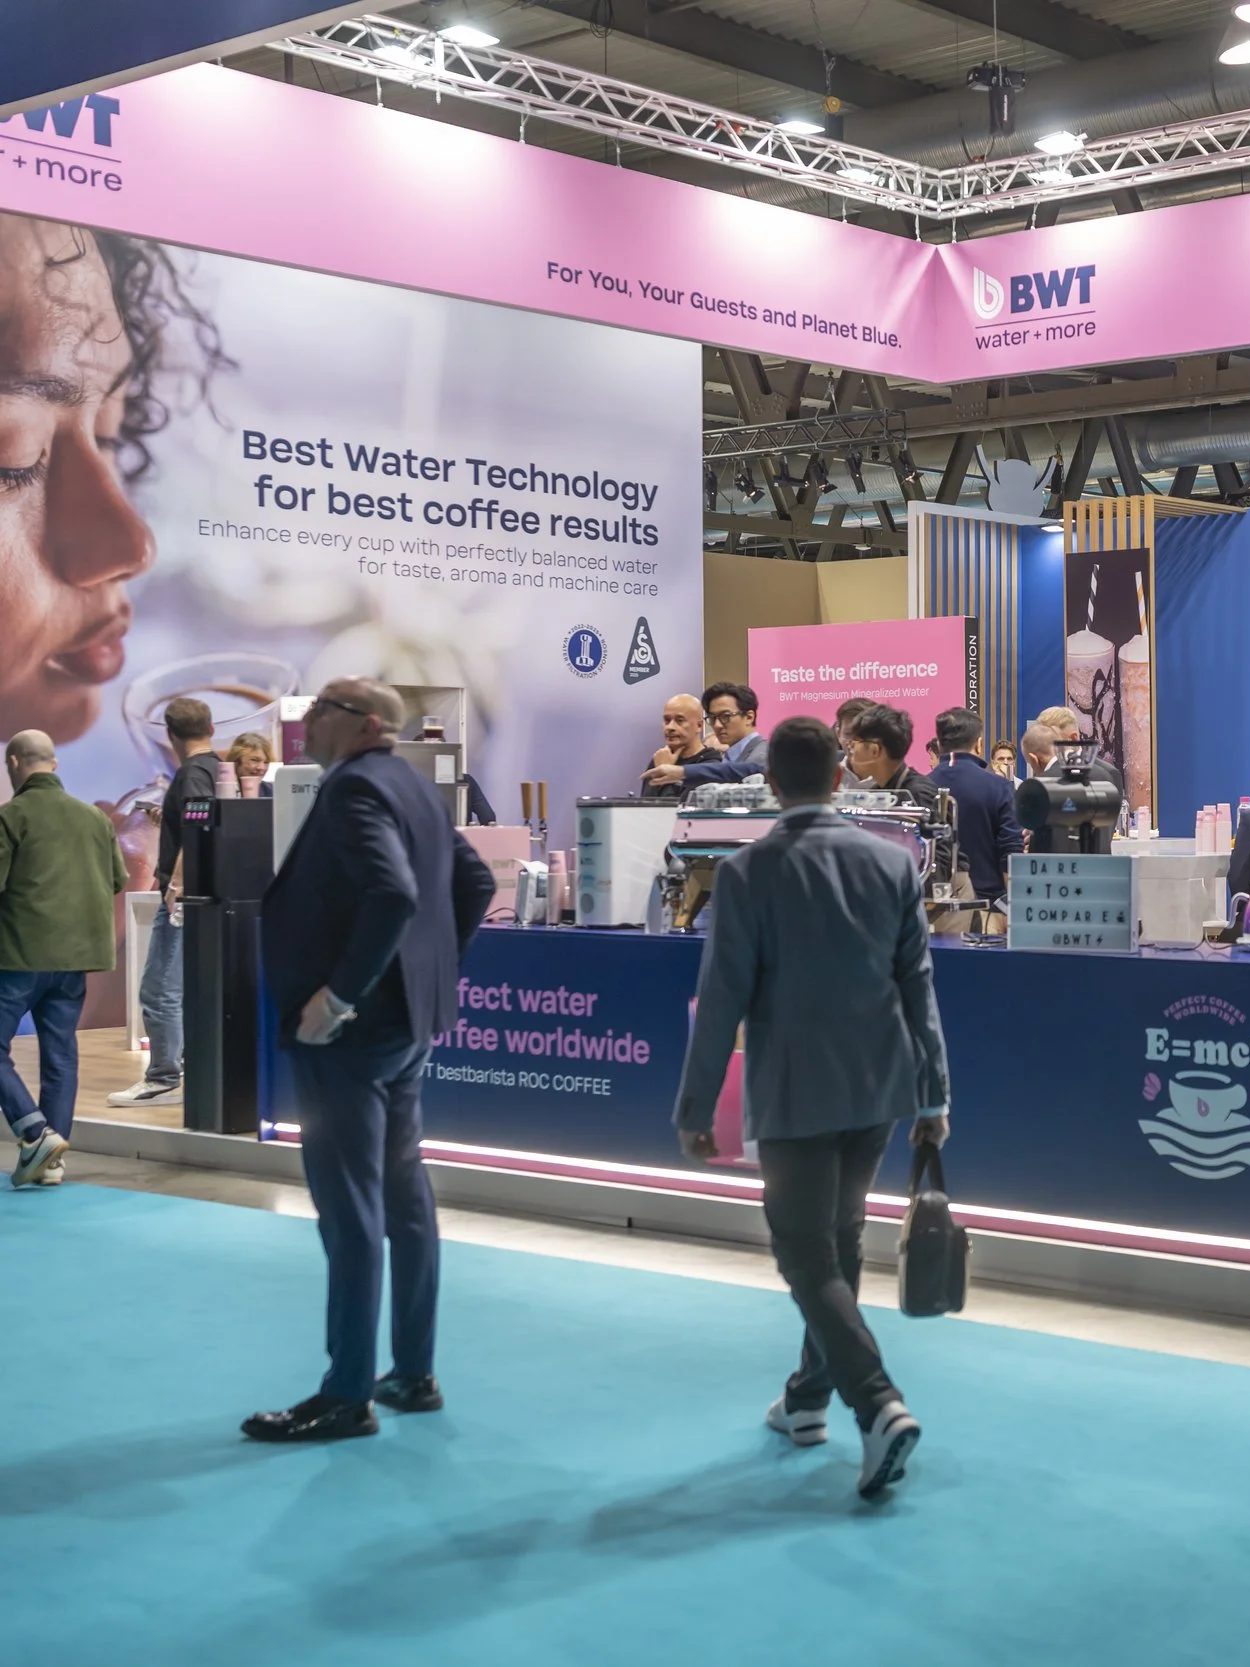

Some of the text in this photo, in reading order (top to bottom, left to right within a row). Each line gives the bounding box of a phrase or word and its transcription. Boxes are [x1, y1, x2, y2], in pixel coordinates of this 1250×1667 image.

[0, 93, 120, 147] WT
[36, 157, 122, 191] more
[547, 261, 902, 348] For You, Your Guests and Planet Blue.
[1010, 264, 1096, 314] BWT
[975, 330, 1030, 350] water
[1046, 321, 1096, 341] more
[243, 430, 658, 511] Best Water Technology
[254, 474, 659, 546] for best coffee results
[198, 519, 658, 575] Enhance every cup with perfectly balanced water
[358, 556, 658, 596] for taste, aroma and machine care
[566, 662, 598, 679] FILTRATION
[597, 638, 608, 672] SPONSOR
[771, 661, 938, 684] Taste the difference
[779, 687, 929, 703] BWT Magnesium Mineralized Water
[1052, 934, 1092, 946] @BWT
[456, 977, 598, 1016] fect water
[1164, 995, 1246, 1023] PERFECT COFFEE
[1174, 1005, 1236, 1026] WORLDWIDE
[504, 1027, 650, 1064] worldwide
[437, 1063, 515, 1086] bestbarista
[519, 1071, 549, 1089] ROC
[553, 1074, 611, 1095] COFFEE
